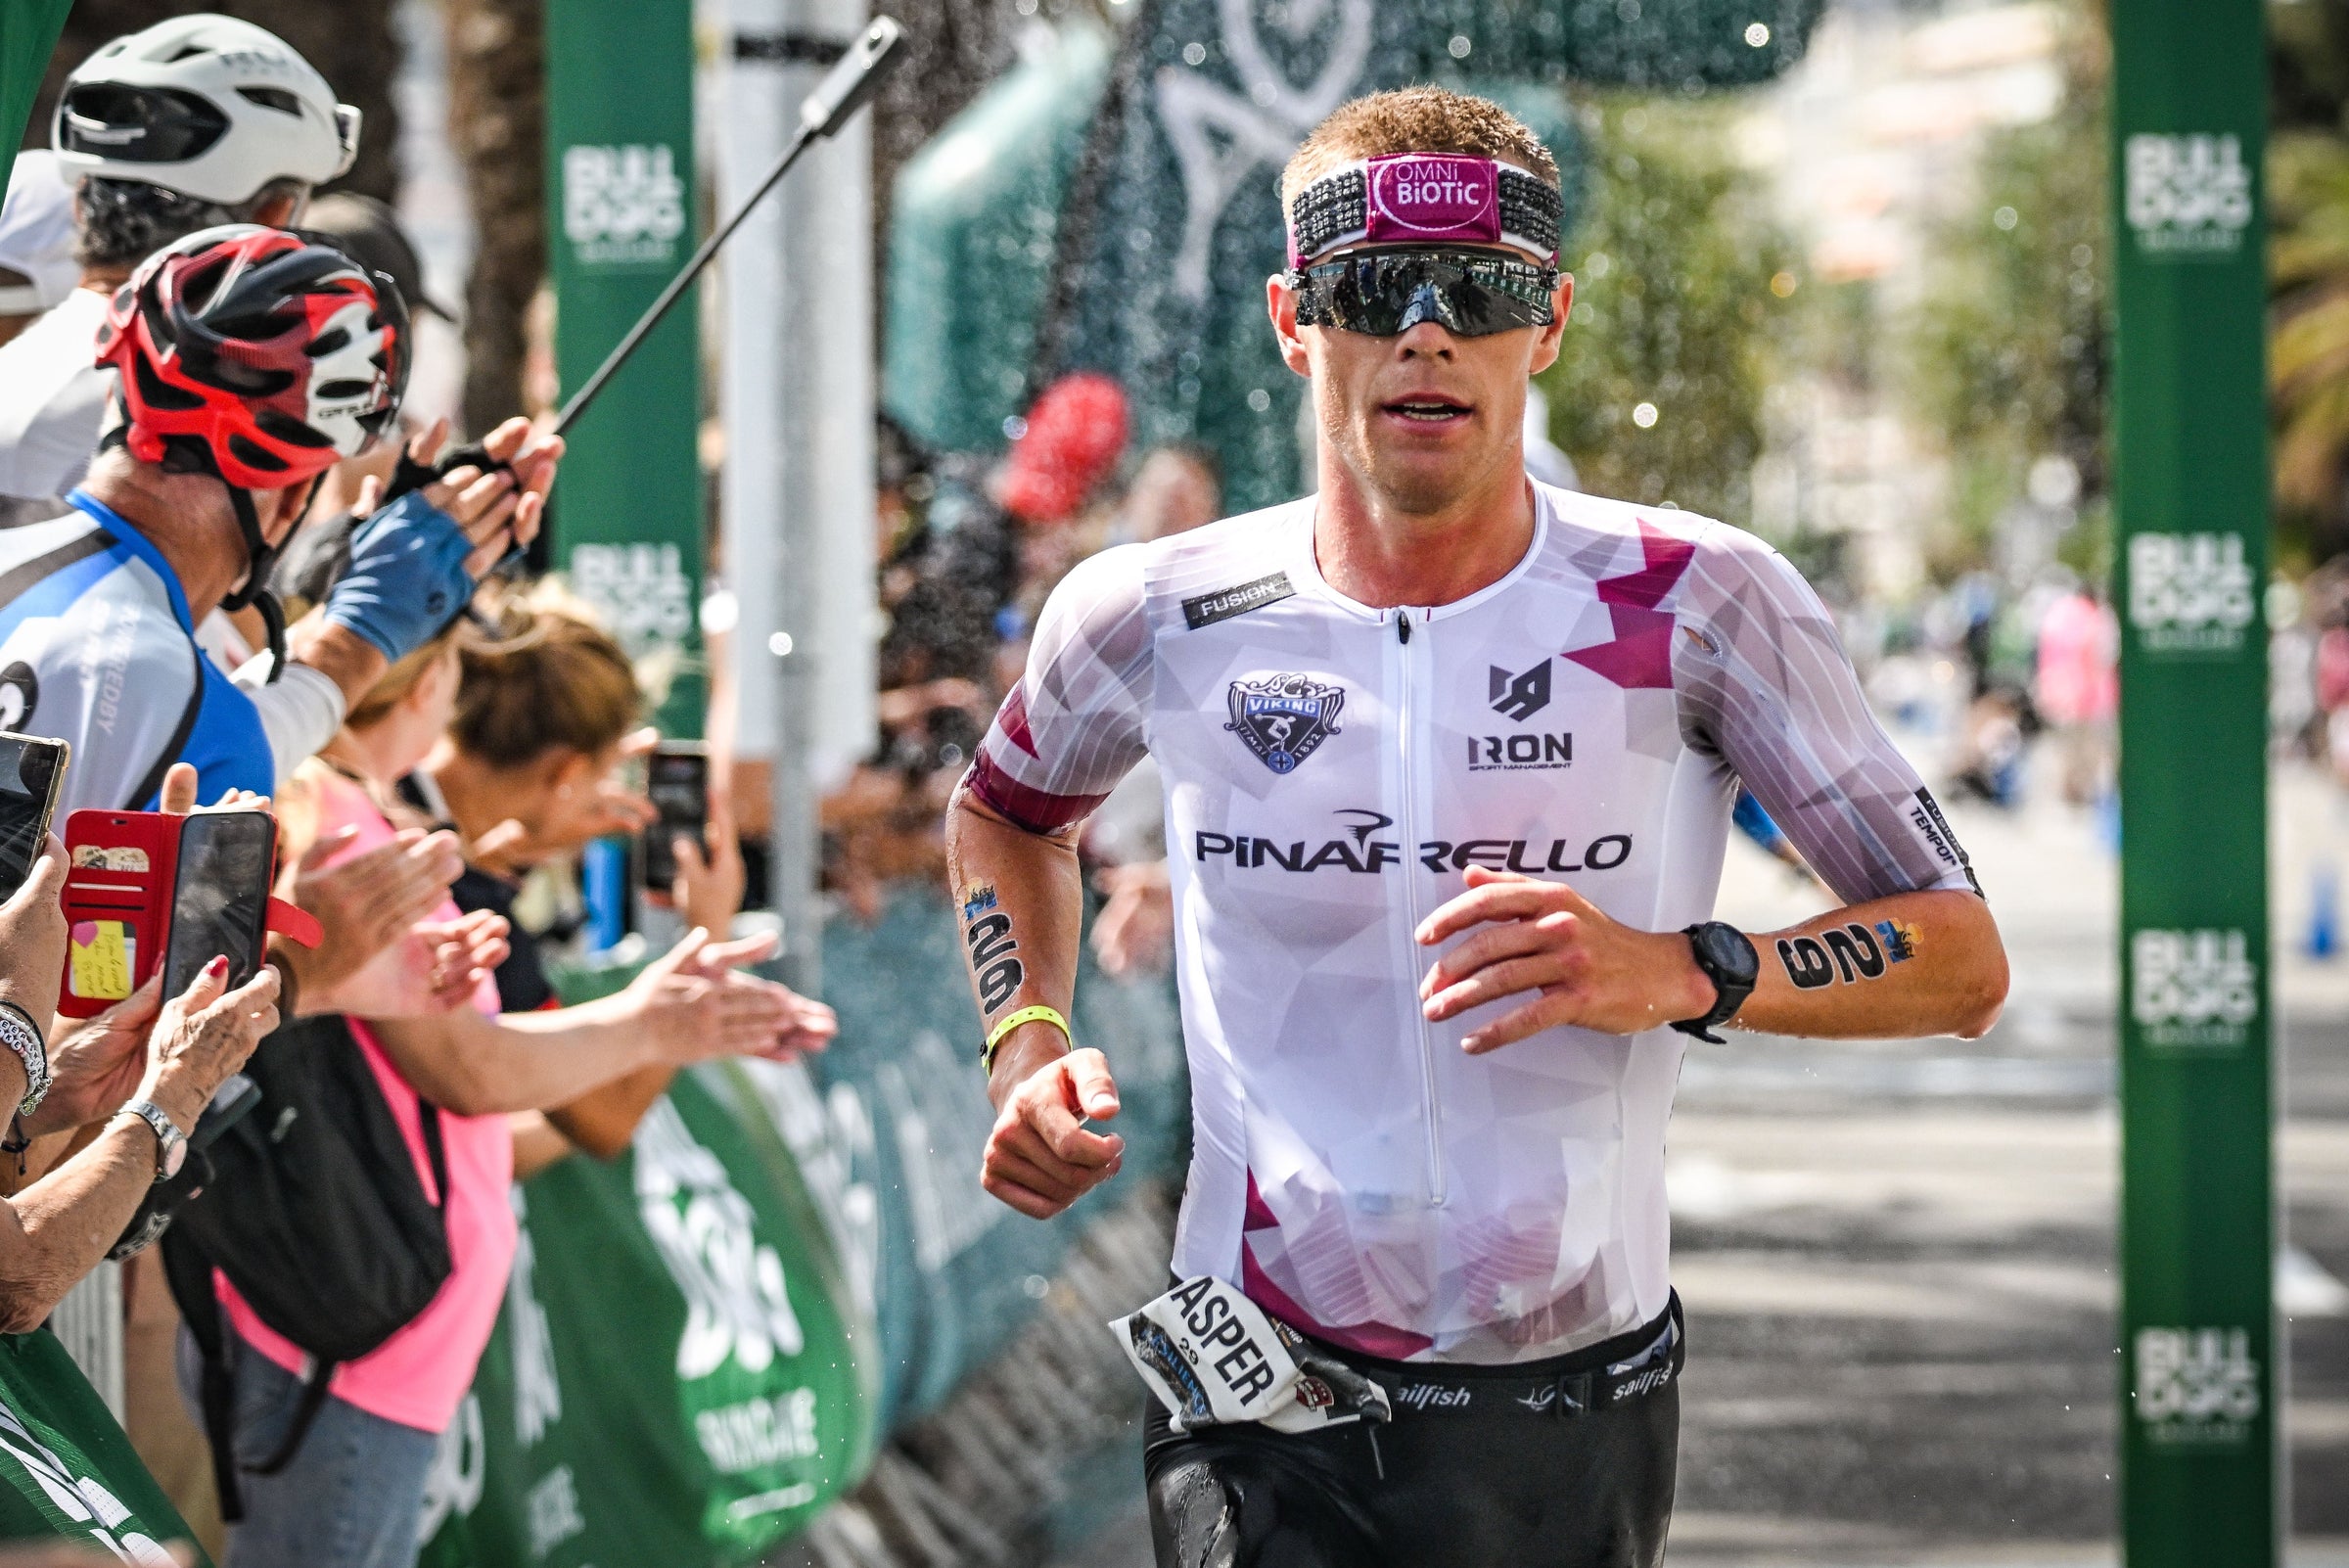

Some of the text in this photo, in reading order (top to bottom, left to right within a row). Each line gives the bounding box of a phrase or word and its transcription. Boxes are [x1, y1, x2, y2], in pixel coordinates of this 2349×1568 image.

[1200, 582, 1276, 617] FUSION
[1249, 699, 1316, 714] VIKING
[1295, 733, 1321, 759] 1892
[1468, 732, 1572, 763] IRON
[967, 911, 1026, 1017] 29
[1775, 921, 1887, 991] 29
[1170, 1276, 1274, 1407] ASPER
[1178, 1337, 1199, 1365] 29
[1397, 1384, 1471, 1410] ailfish
